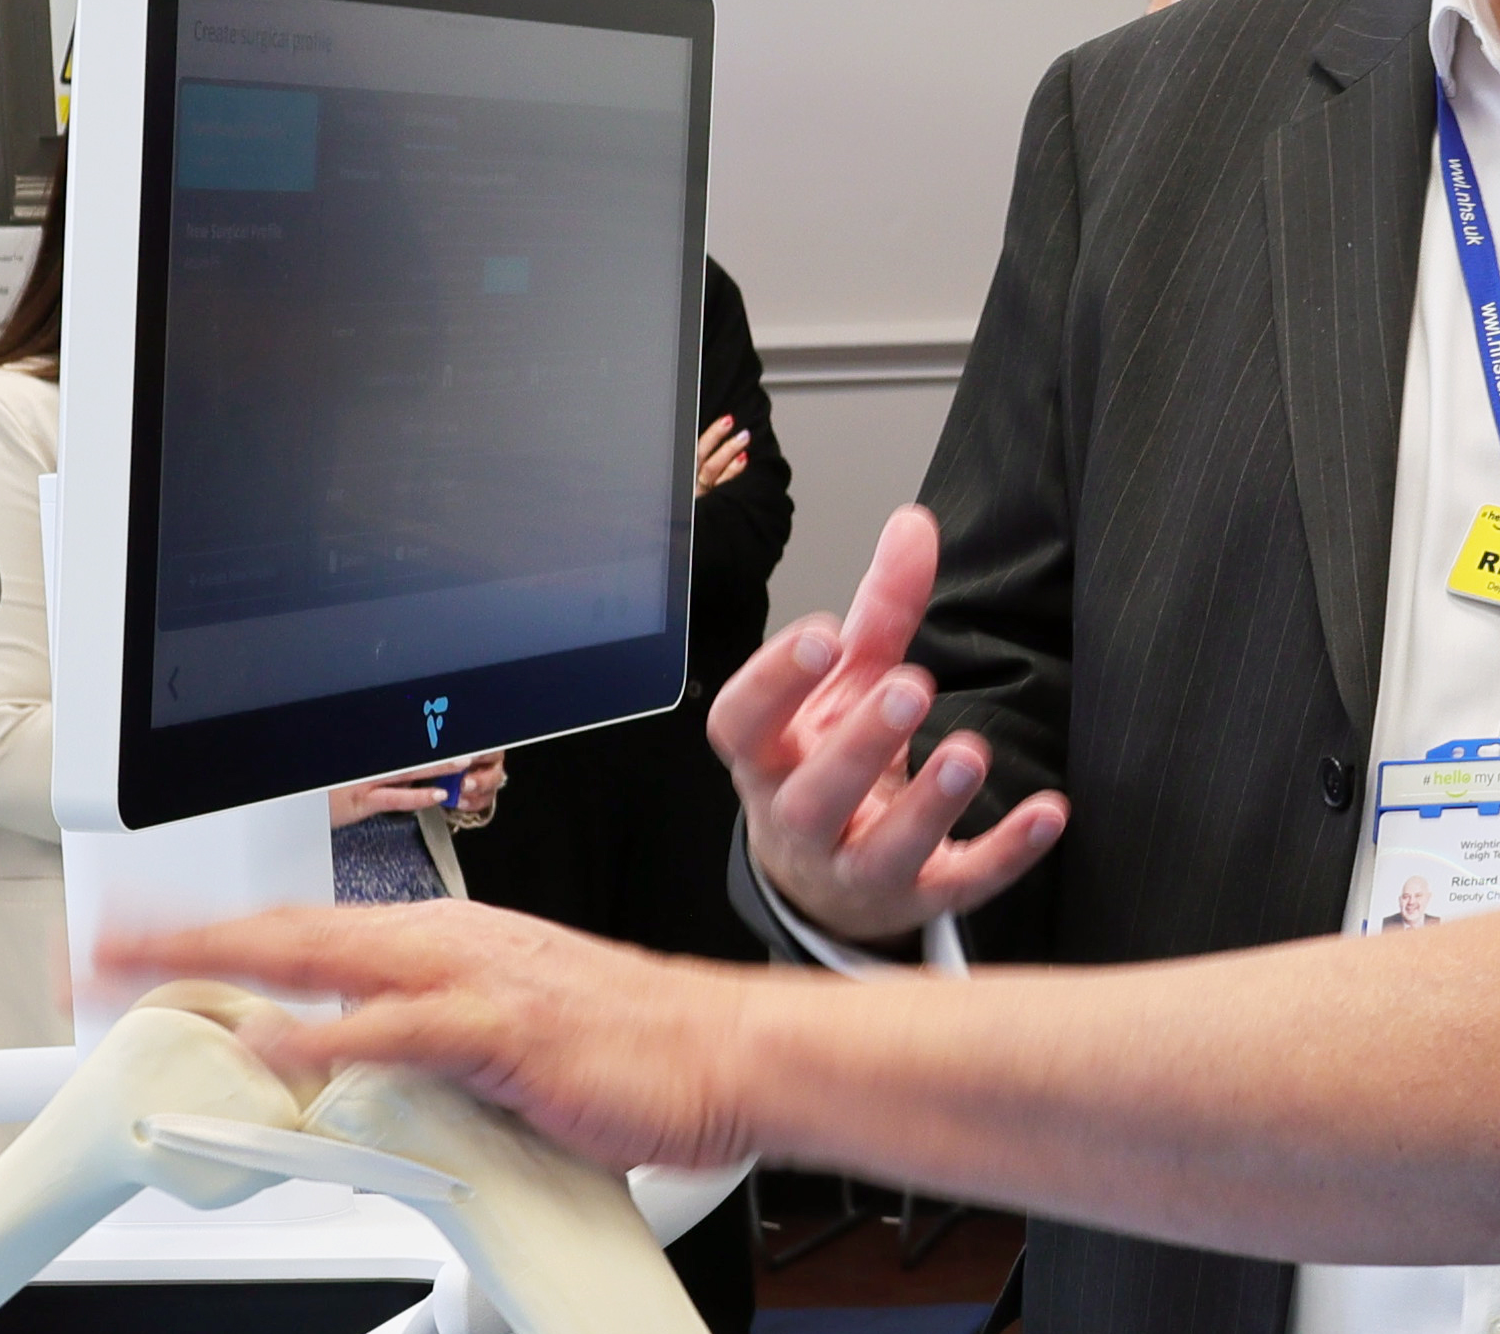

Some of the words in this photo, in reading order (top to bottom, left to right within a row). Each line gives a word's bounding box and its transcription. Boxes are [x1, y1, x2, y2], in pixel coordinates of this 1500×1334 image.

[1448, 158, 1485, 246] wwl.nhs.uk
[1423, 775, 1431, 785] #
[1433, 769, 1472, 785] hello
[1474, 773, 1495, 786] my
[1464, 850, 1490, 862] Leigh
[1451, 875, 1498, 887] Richard
[1449, 891, 1485, 903] Deputy
